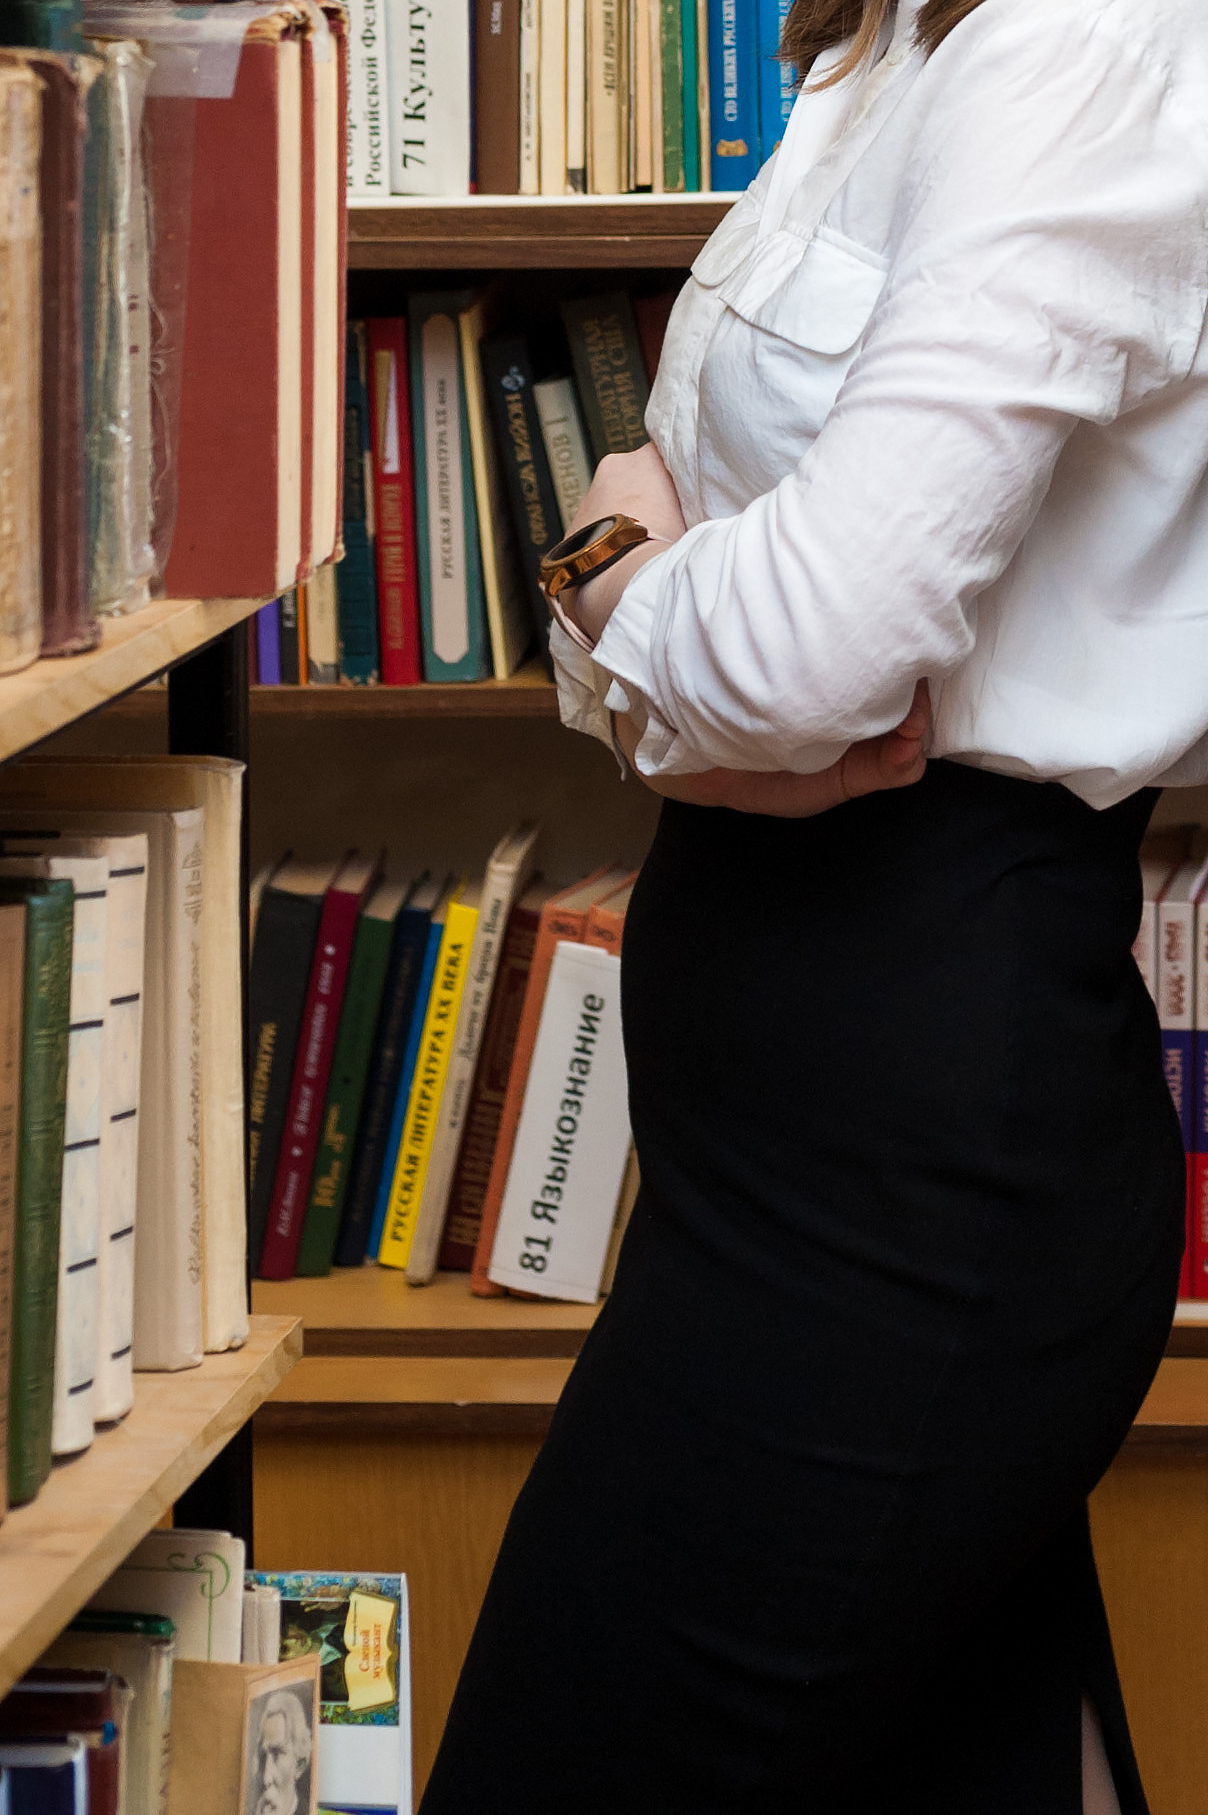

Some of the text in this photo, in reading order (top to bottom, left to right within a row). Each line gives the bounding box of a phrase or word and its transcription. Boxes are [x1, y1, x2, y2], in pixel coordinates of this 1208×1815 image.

[361, 56, 383, 187] Российской
[401, 137, 426, 169] 71
[434, 429, 452, 514] ЛИТЕРАТУРА
[437, 516, 454, 579] РУССКАЯ
[386, 941, 464, 1243] РУССКАЯ ЛИТЕРАТУРА XX ВЕКА
[515, 989, 609, 1274] 81 Языкознание
[357, 1628, 371, 1673] Слепой
